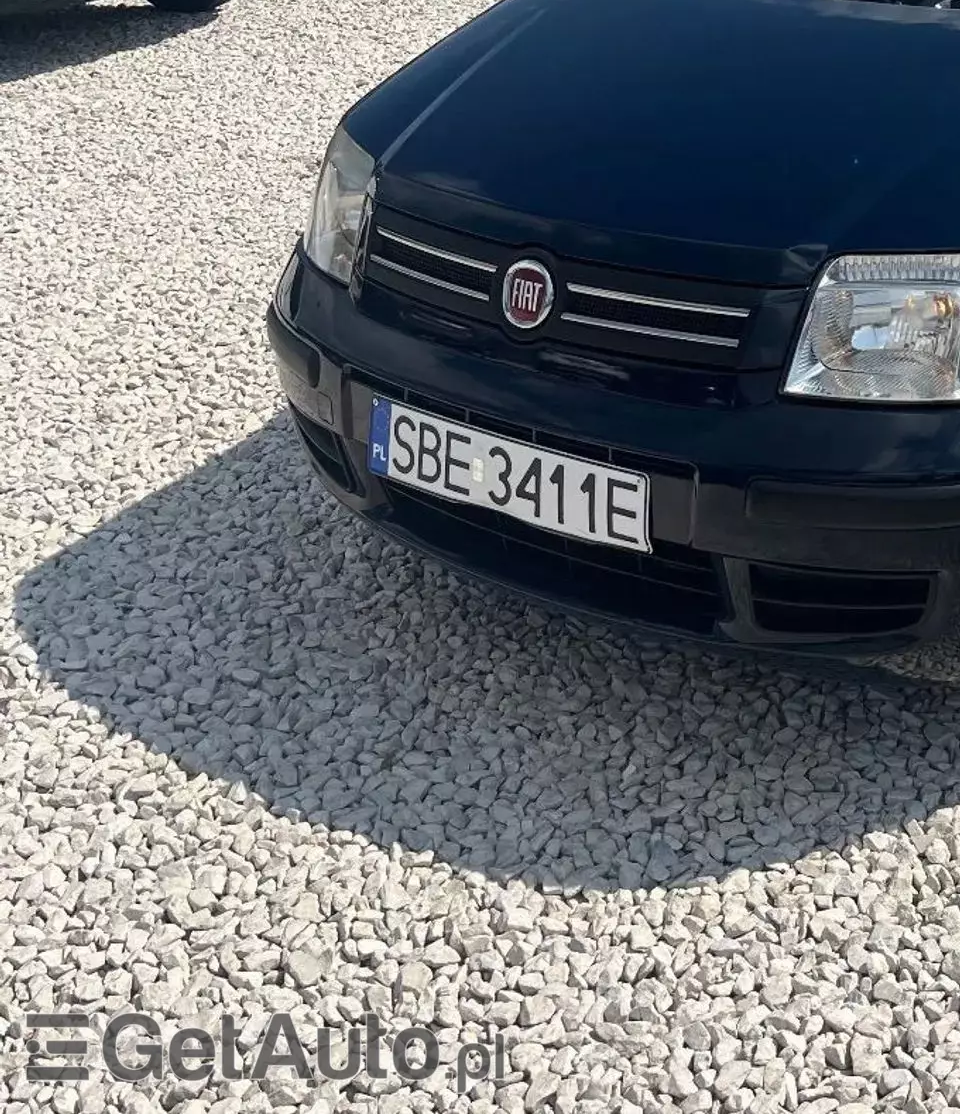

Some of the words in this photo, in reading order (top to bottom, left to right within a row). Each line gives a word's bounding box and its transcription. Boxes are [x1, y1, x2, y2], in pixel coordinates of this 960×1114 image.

[512, 278, 543, 313] FIAT
[372, 444, 387, 462] PL
[392, 414, 472, 497] SBE
[488, 445, 640, 545] 3411E
